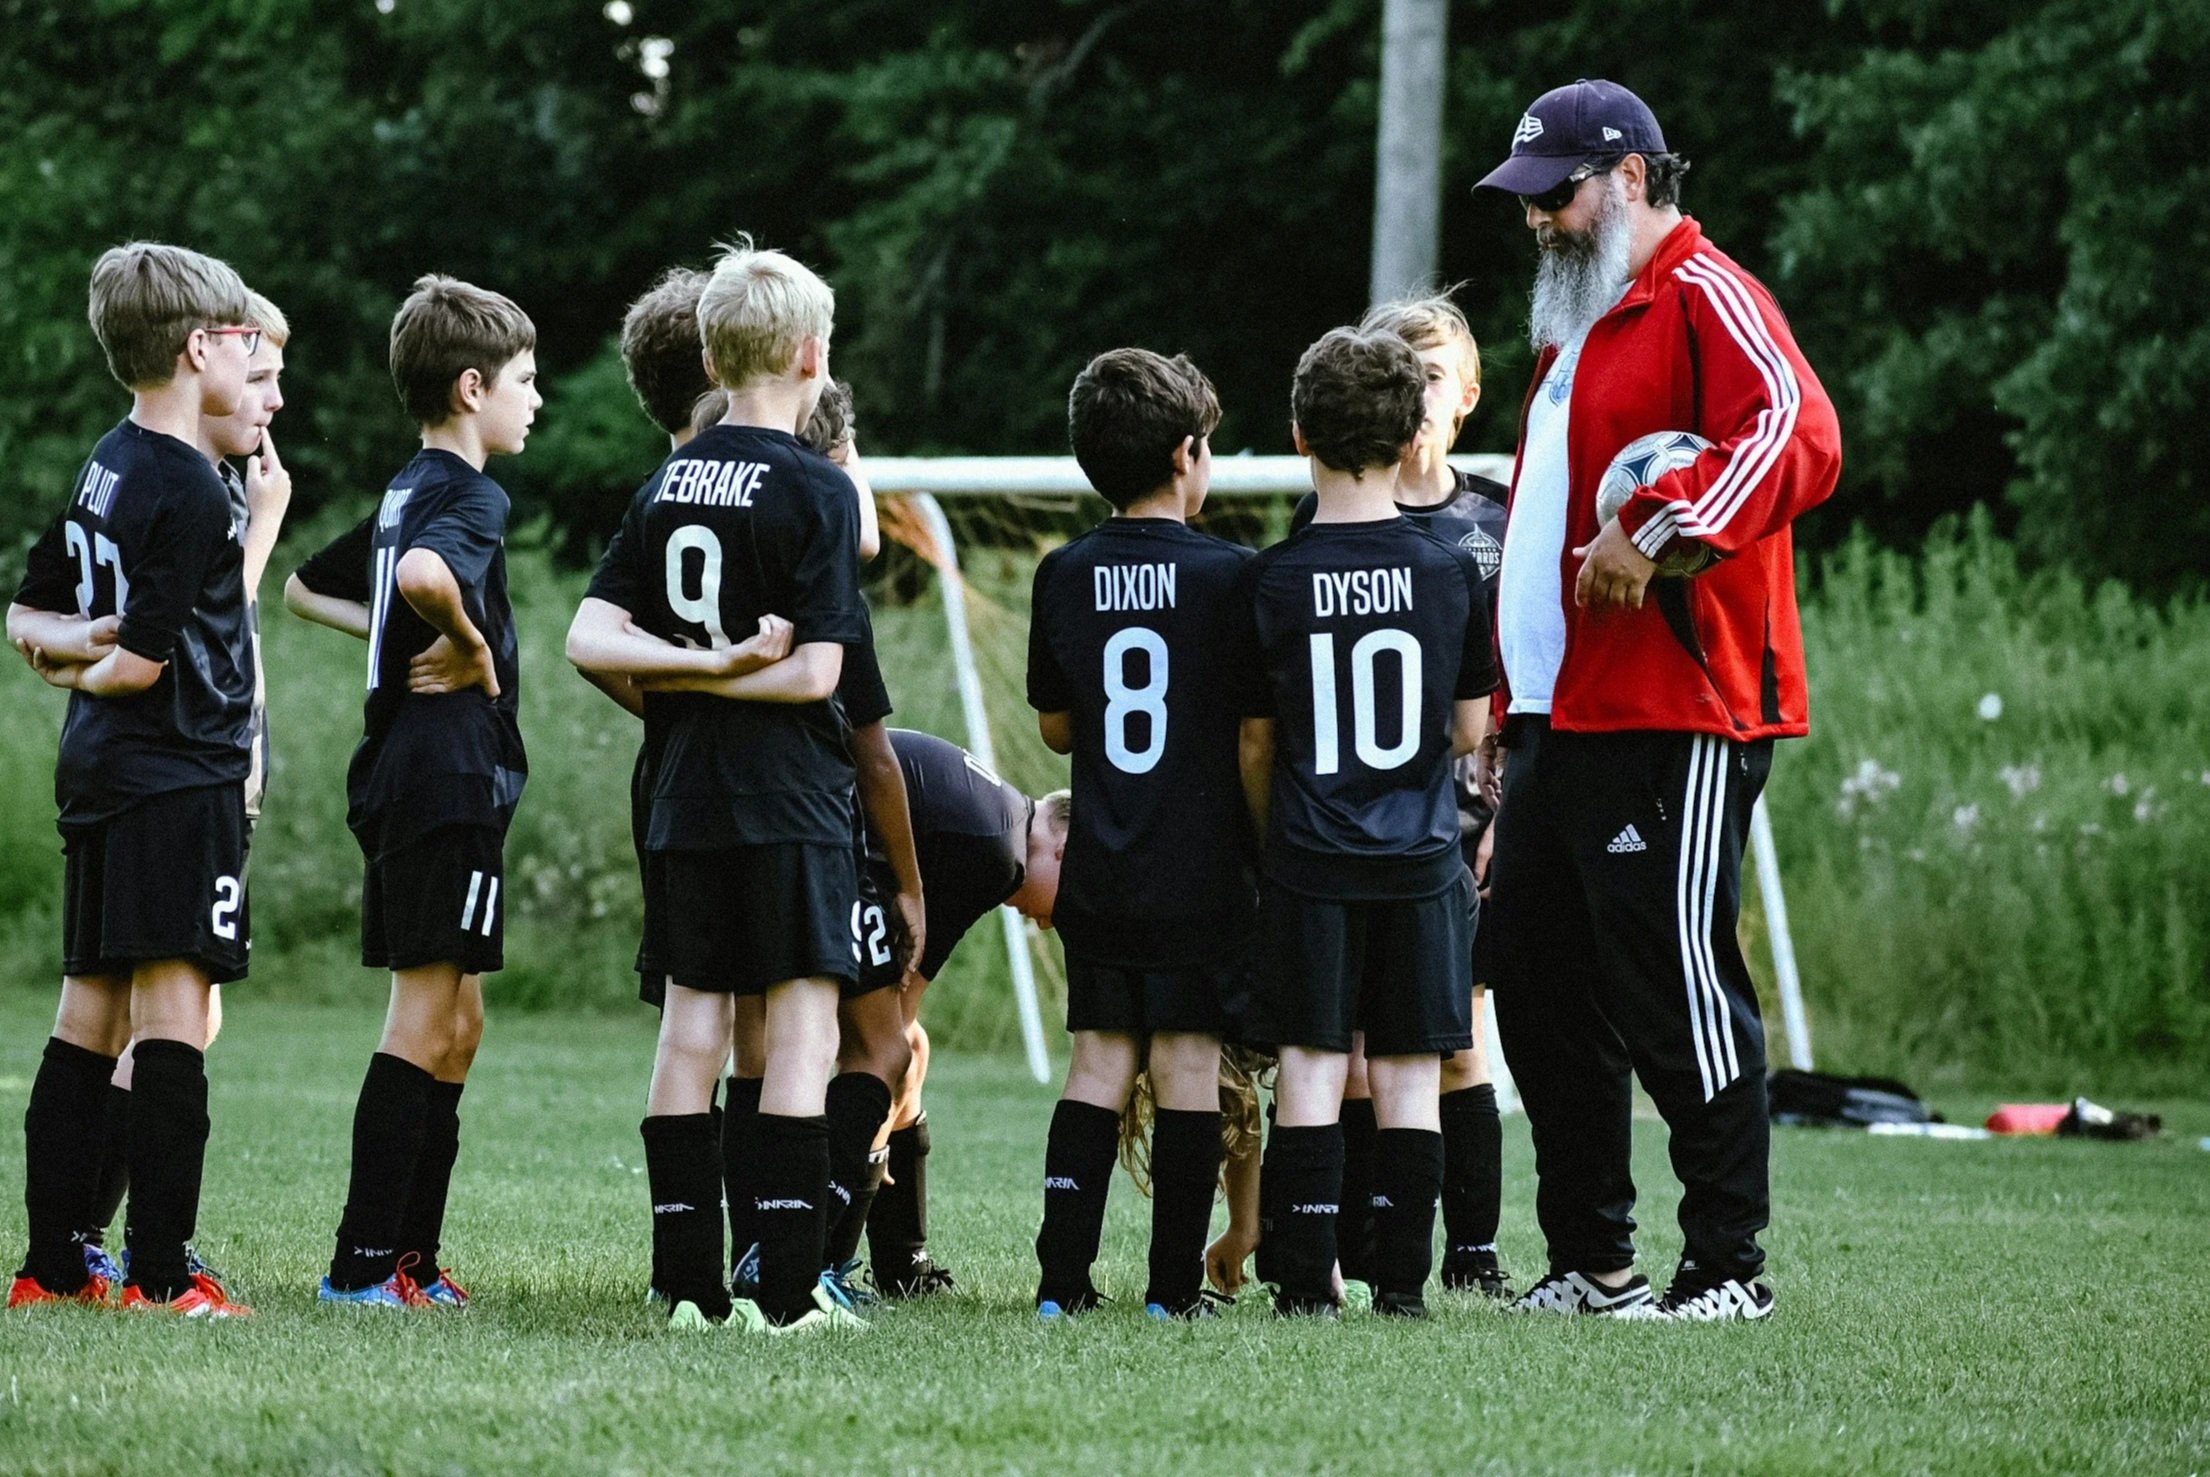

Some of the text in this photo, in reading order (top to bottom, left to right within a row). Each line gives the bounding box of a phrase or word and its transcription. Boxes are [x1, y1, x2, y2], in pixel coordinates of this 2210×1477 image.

[666, 524, 731, 650] 9
[1094, 562, 1176, 611] DIXON
[1312, 567, 1413, 617] DYSON
[1103, 626, 1169, 774] 8
[1309, 628, 1422, 775] 10
[1607, 841, 1647, 853] adidas
[460, 870, 499, 937] 11
